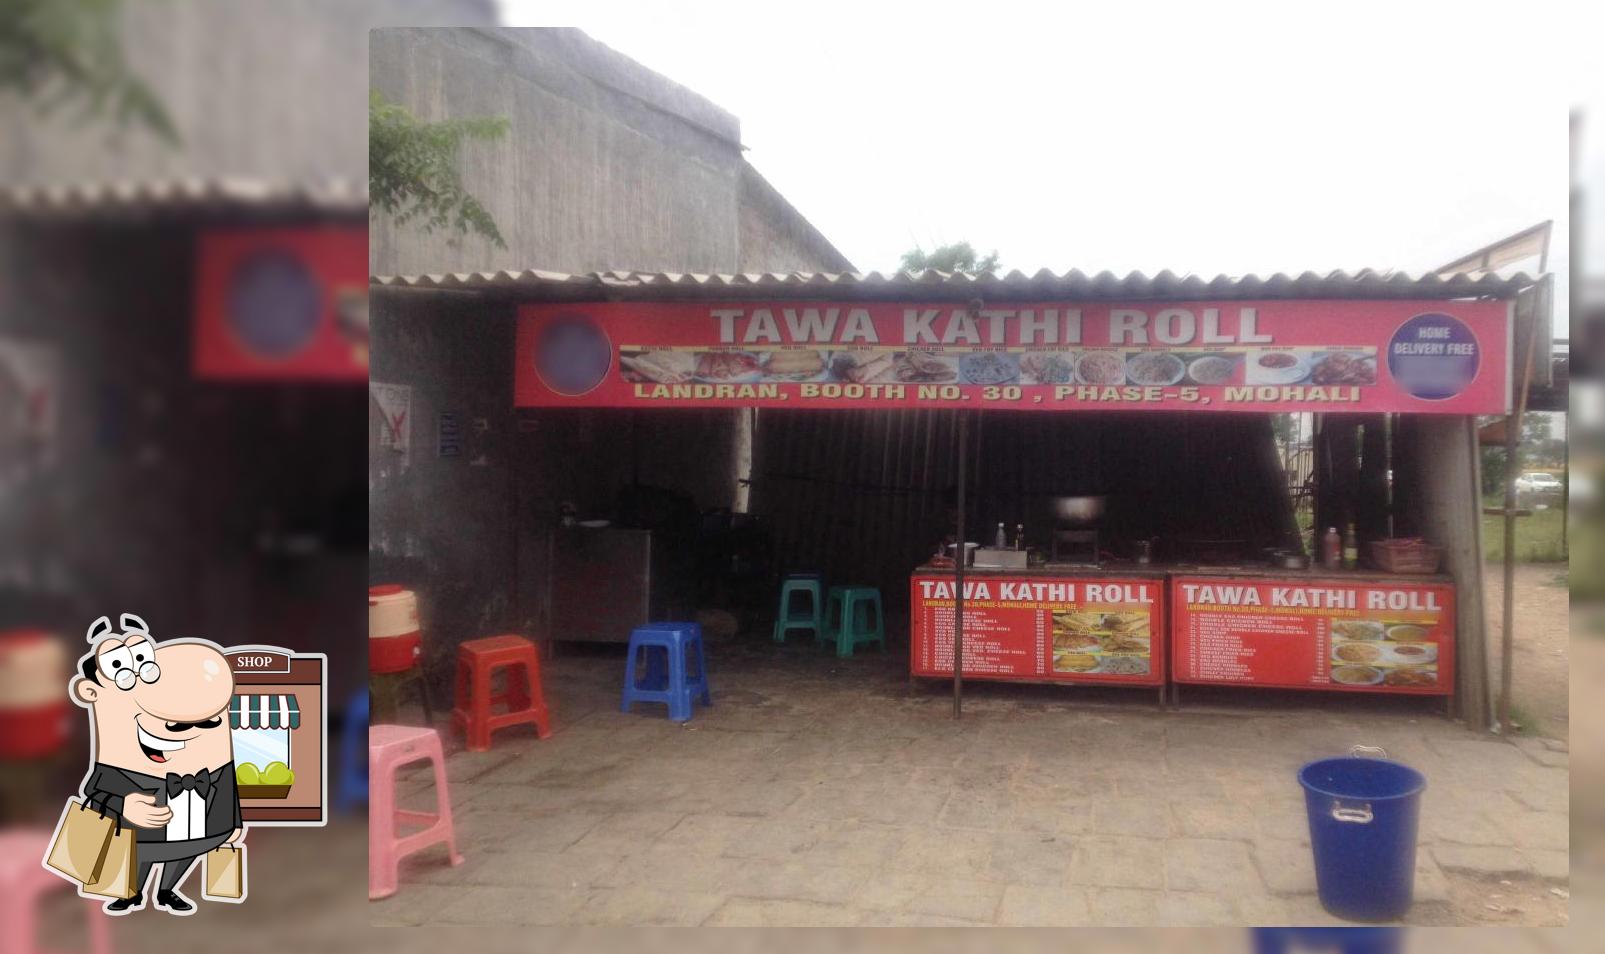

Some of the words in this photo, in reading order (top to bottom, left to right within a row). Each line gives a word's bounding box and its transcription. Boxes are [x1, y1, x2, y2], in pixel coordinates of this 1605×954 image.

[710, 308, 880, 345] TAWA
[902, 308, 1083, 345] KATHI
[1109, 307, 1274, 345] ROLL
[1418, 327, 1451, 339] HOME
[1394, 342, 1445, 355] DELIVERY
[1447, 343, 1475, 356] FREE
[634, 383, 789, 401] LANDRAN,
[800, 383, 906, 400] BOOTH
[918, 385, 970, 401] NO.
[983, 386, 1023, 401] 30
[1054, 385, 1212, 405] PHASE-5,
[1224, 385, 1361, 403] MOHALI
[919, 581, 990, 601] TAWA
[999, 583, 1075, 602] KATHI
[1085, 585, 1154, 604] ROLL
[1183, 584, 1262, 606] TAWA
[1272, 587, 1358, 610] KATHI
[1368, 590, 1442, 612] ROLL
